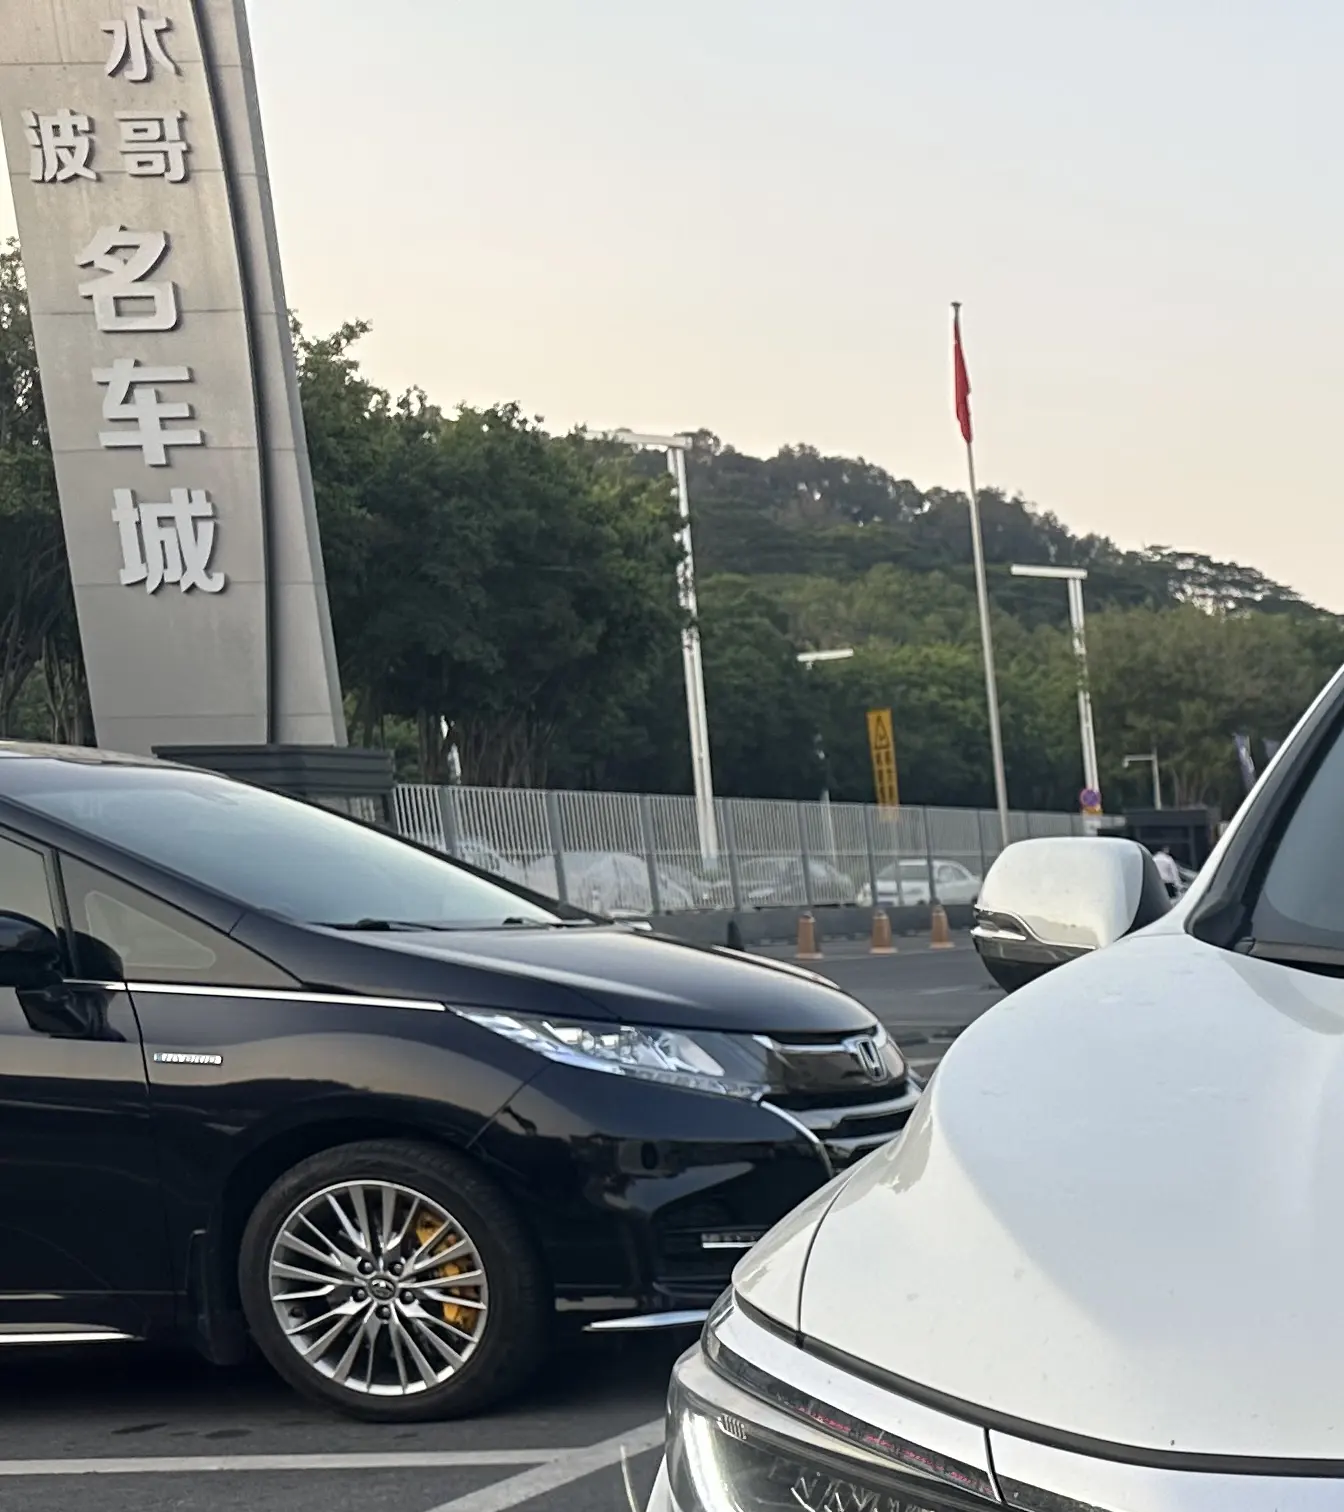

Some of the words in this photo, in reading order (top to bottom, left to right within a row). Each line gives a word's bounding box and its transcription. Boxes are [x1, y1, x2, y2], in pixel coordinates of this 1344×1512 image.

[20, 107, 191, 184] 波哥
[75, 223, 226, 595] 名车城
